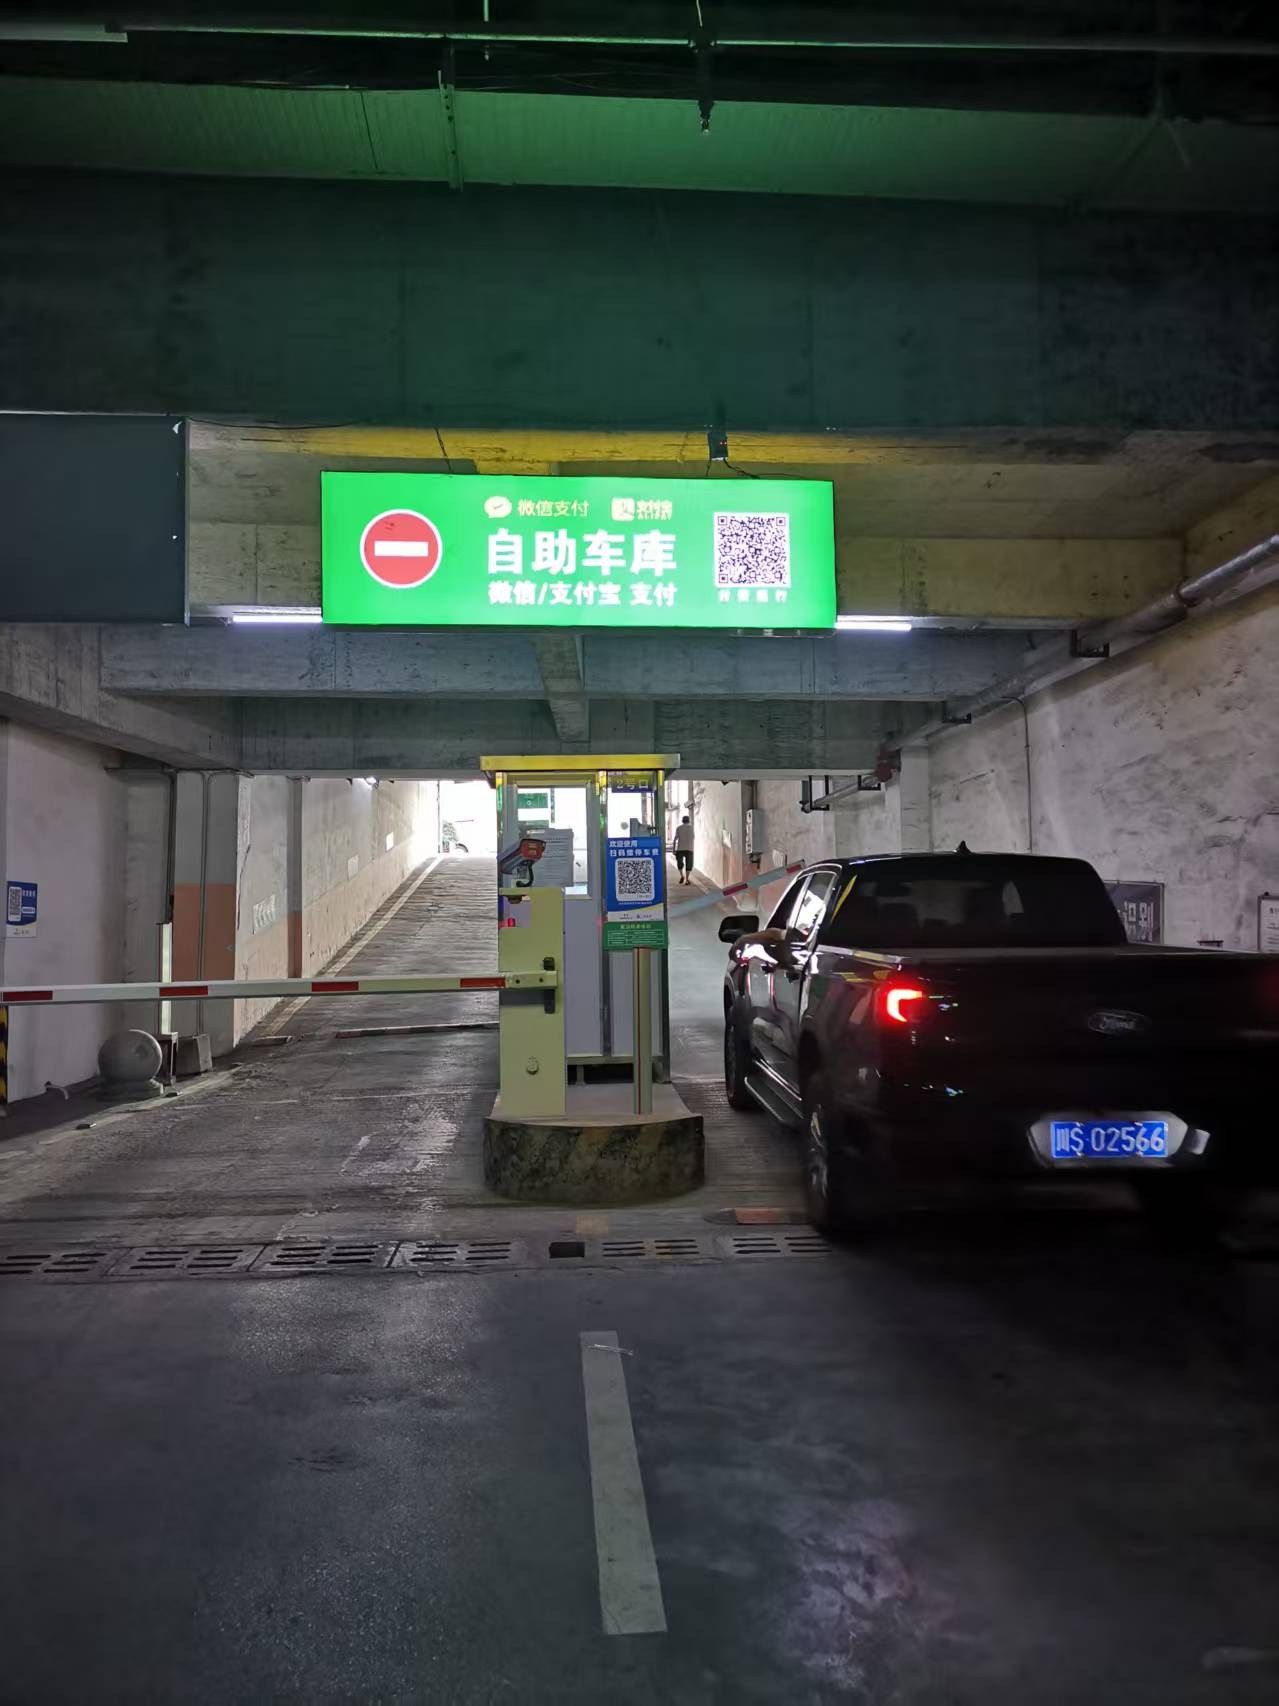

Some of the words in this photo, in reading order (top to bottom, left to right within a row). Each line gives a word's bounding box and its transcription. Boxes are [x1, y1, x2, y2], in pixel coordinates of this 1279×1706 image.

[517, 500, 589, 517] 微信支付
[487, 528, 677, 576] 自助车库
[487, 581, 622, 606] 微信/支付宝
[629, 582, 678, 607] 支付
